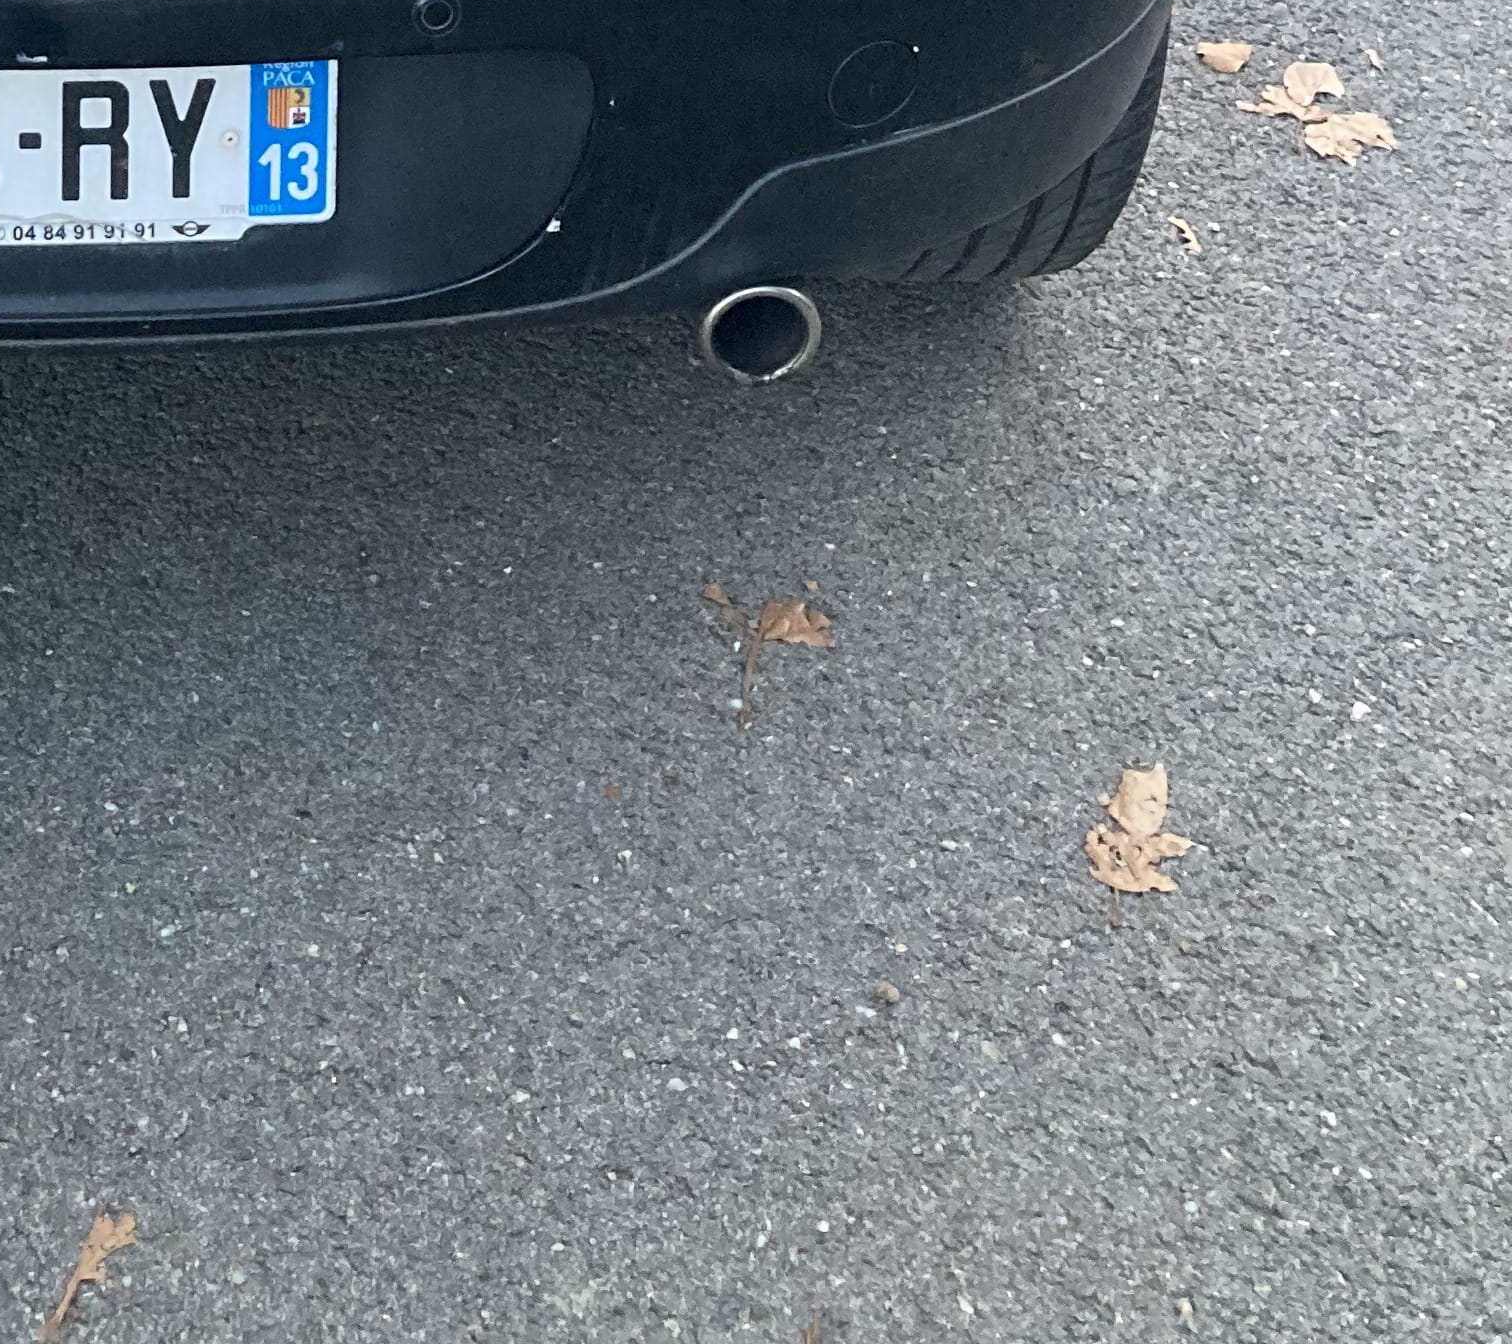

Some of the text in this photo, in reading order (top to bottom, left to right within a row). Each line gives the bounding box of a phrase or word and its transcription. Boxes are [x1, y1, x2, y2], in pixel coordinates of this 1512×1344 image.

[263, 70, 315, 87] PACA
[258, 141, 319, 201] 13
[12, 226, 36, 241] 04
[43, 225, 66, 240] 84
[73, 224, 95, 240] 91
[135, 223, 155, 238] 91
